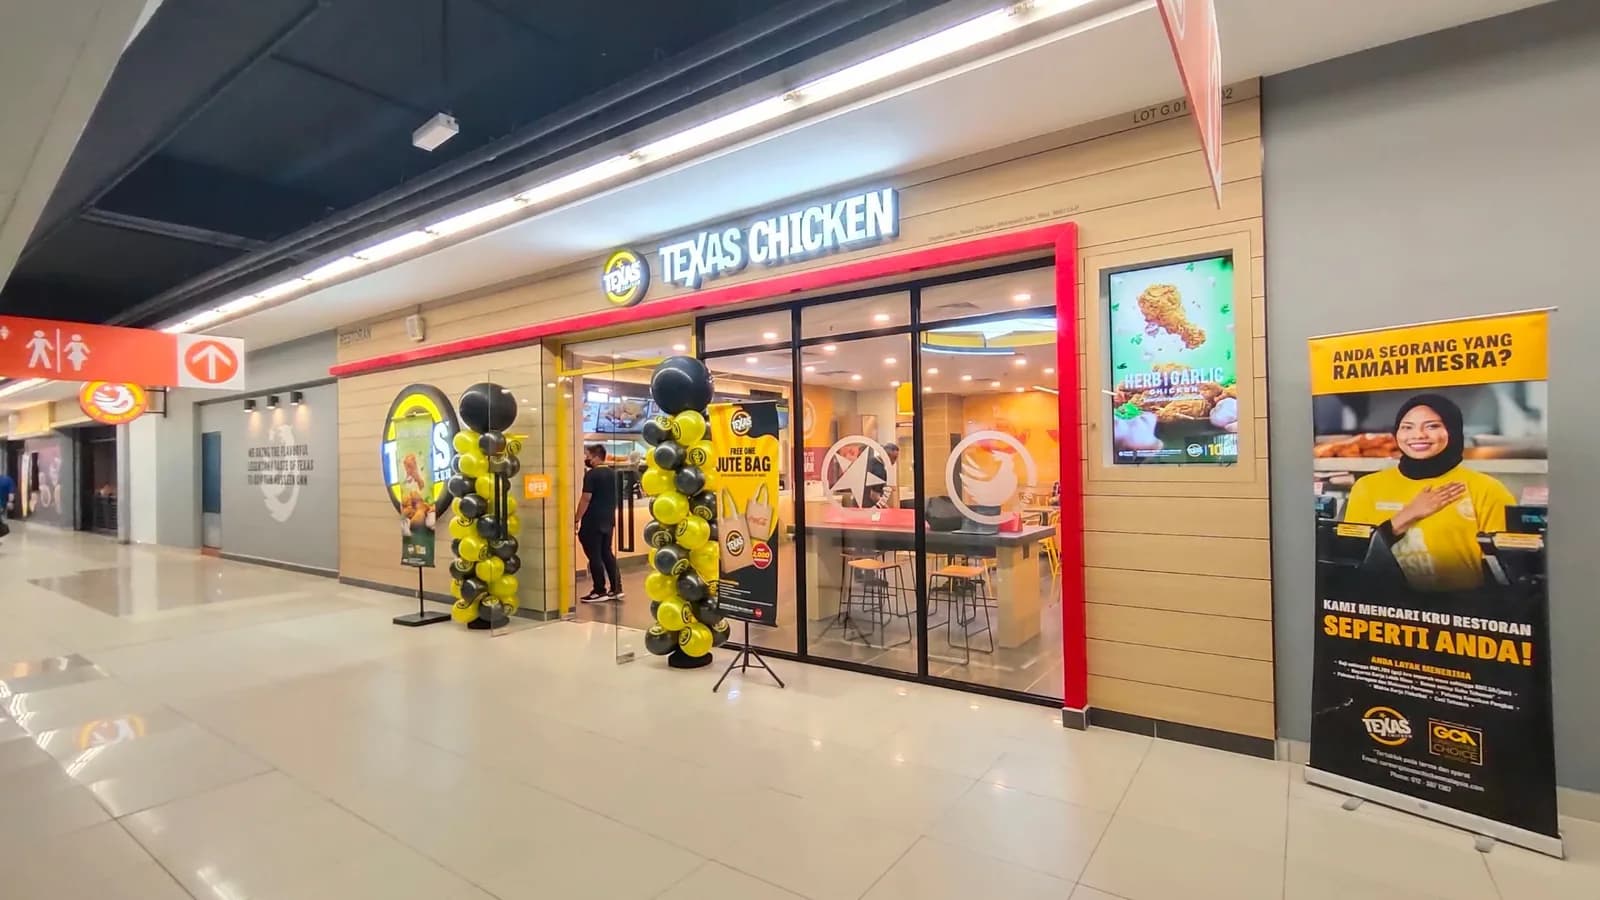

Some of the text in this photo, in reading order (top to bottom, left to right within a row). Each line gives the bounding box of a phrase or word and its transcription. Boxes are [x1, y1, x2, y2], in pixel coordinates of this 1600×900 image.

[1133, 108, 1157, 123] LOT
[659, 188, 894, 288] TEXAS CHICKEN
[603, 260, 641, 293] TEXAS
[1333, 333, 1512, 363] ANDA SEORANG YANG
[1333, 349, 1512, 380] RAMAH MESRA?
[1125, 367, 1223, 389] HERB GARLIC
[1150, 387, 1198, 395] CHICKEN
[730, 447, 756, 455] FREE ONE
[716, 456, 771, 472] JUTE BAG
[1323, 599, 1532, 636] KAMI MENCARI KRU RESTORAN
[1324, 615, 1532, 666] SEPERTI ANDA!
[1371, 656, 1472, 680] ANDA LAYAK MENERIMA
[1362, 718, 1411, 737] TEXAS
[1433, 726, 1477, 746] GCA
[1434, 744, 1479, 760] CHOICE
